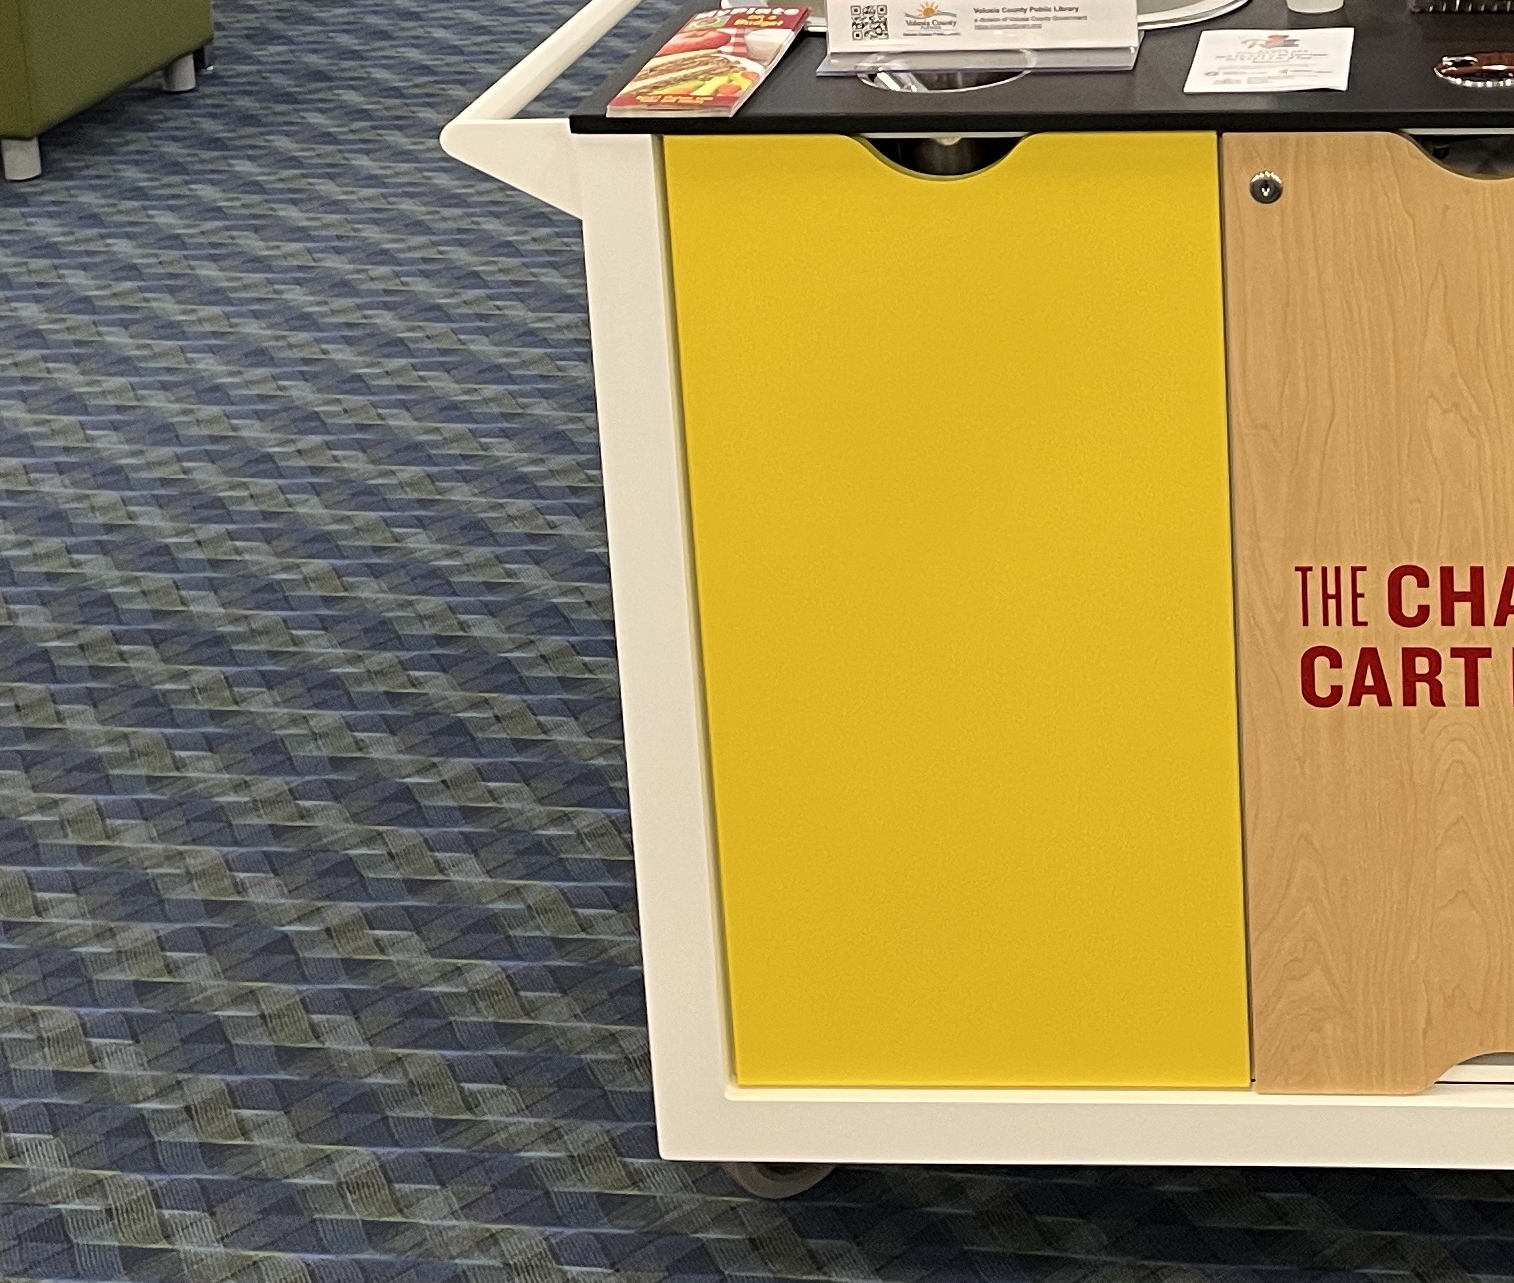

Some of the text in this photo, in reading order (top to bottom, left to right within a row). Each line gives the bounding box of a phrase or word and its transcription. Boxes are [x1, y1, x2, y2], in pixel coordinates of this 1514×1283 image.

[694, 8, 800, 20] MyPlate
[1295, 566, 1368, 626] THE
[1300, 646, 1492, 708] CART
